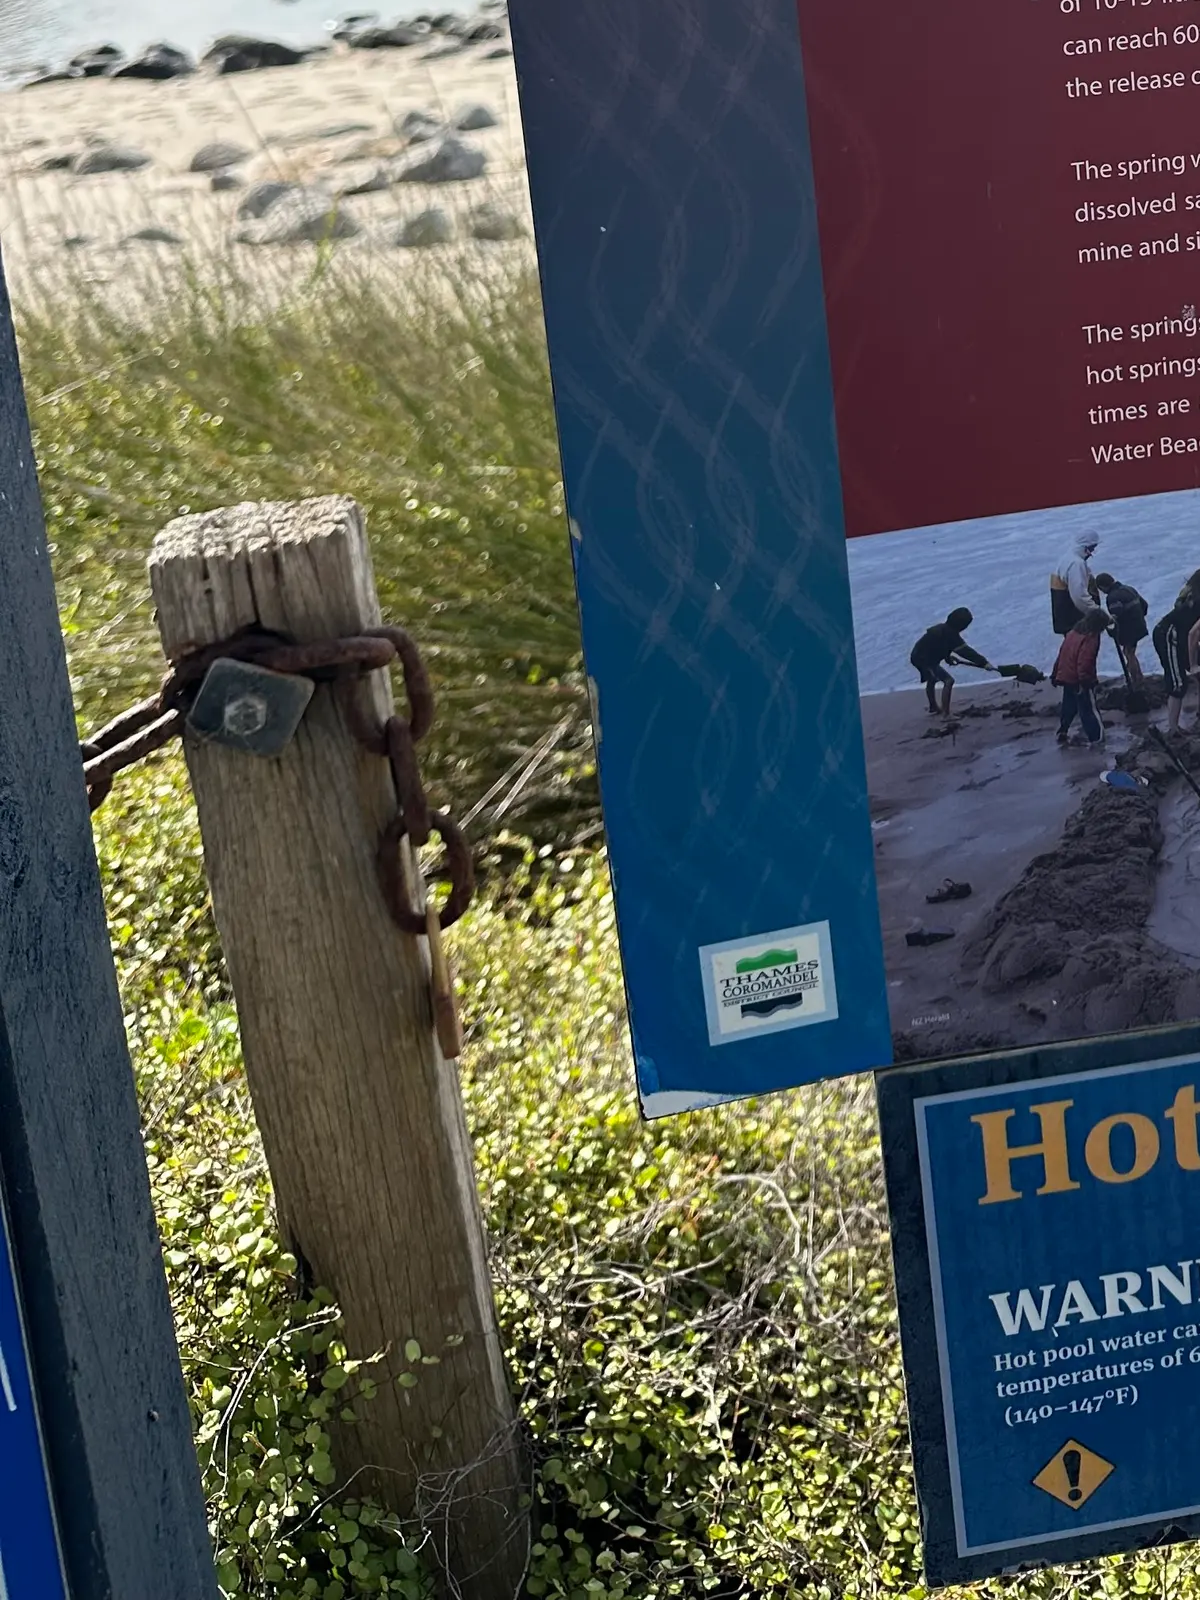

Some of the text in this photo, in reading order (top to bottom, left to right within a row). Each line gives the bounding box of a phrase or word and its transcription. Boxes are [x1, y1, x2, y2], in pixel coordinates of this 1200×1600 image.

[1077, 241, 1133, 263] mine
[1138, 232, 1179, 256] and
[1090, 442, 1154, 464] Water
[720, 959, 819, 988] THAMES
[722, 971, 818, 998] COROMANDEL
[993, 1349, 1037, 1371] Hot
[1042, 1337, 1095, 1367] pool
[1099, 1328, 1167, 1352] water
[995, 1357, 1154, 1397] temperatures
[1159, 1347, 1184, 1368] of
